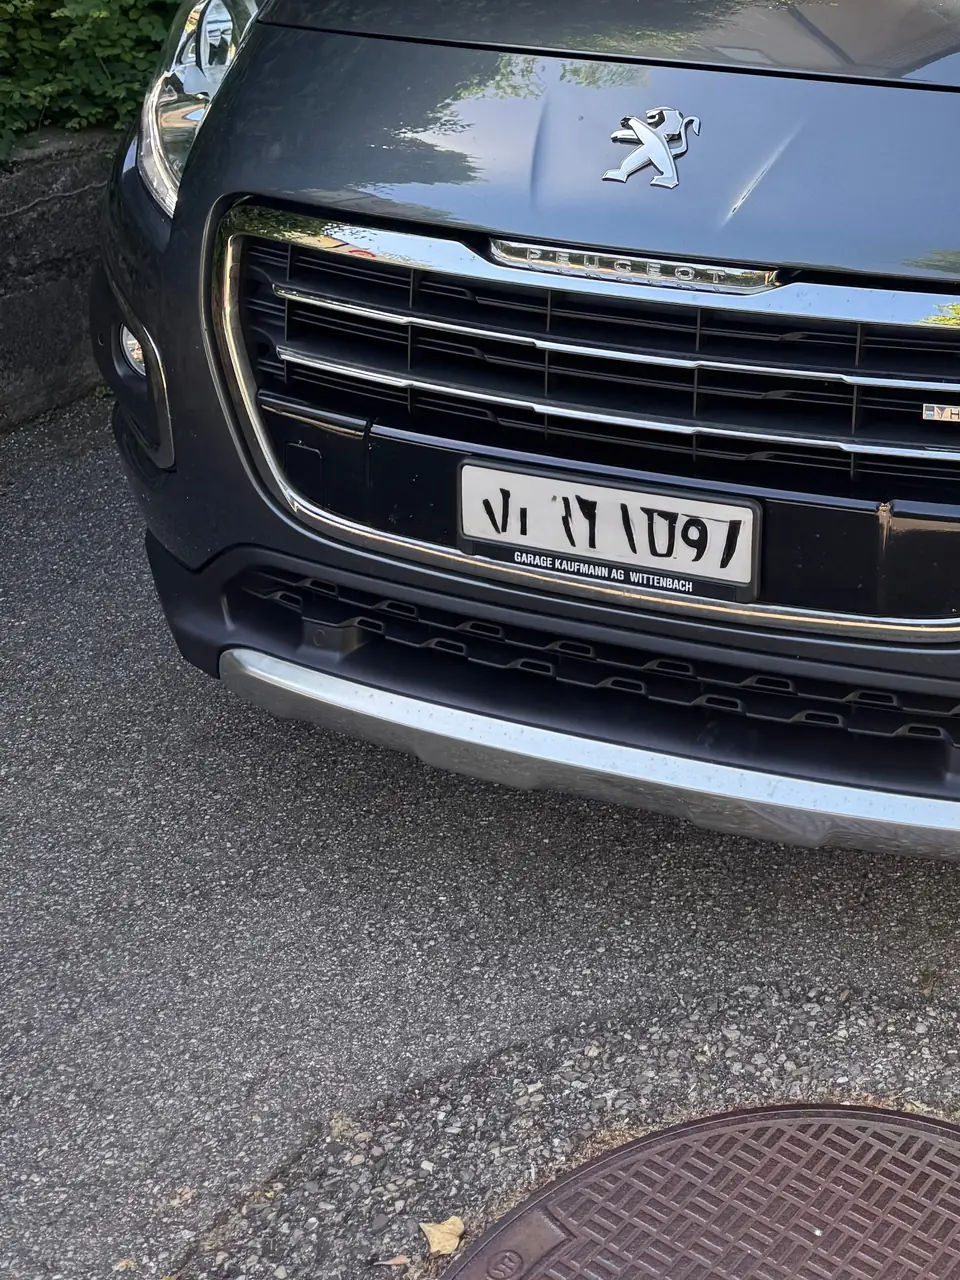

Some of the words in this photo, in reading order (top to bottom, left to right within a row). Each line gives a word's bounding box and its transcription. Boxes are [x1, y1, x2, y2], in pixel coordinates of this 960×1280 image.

[526, 248, 726, 283] PEUGEOT
[514, 551, 553, 568] GARAGE
[554, 558, 609, 578] KAUFMANN
[610, 568, 625, 580] AG
[629, 571, 693, 592] WITTENBACH
